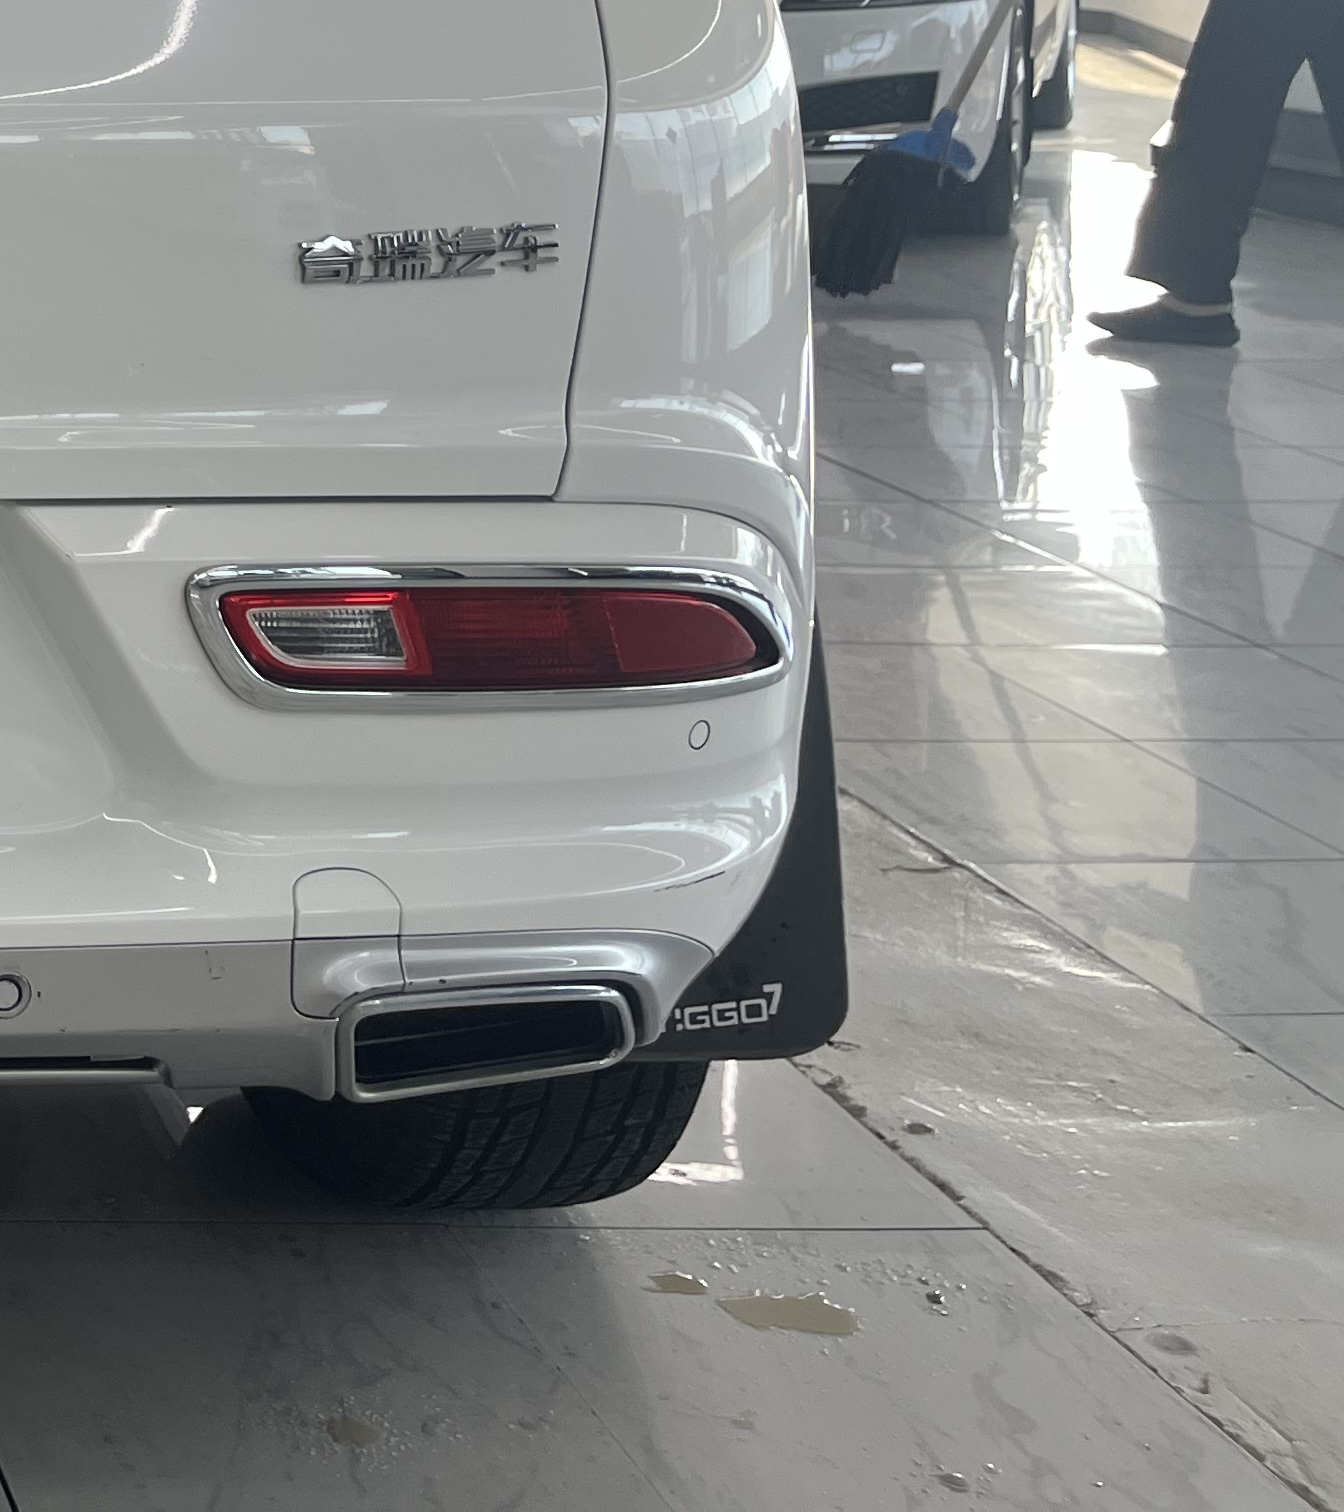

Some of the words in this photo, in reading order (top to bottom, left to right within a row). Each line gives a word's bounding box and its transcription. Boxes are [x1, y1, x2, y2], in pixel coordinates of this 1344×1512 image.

[298, 222, 559, 284] 奇瑞汽车
[668, 982, 783, 1031] IGGO7
